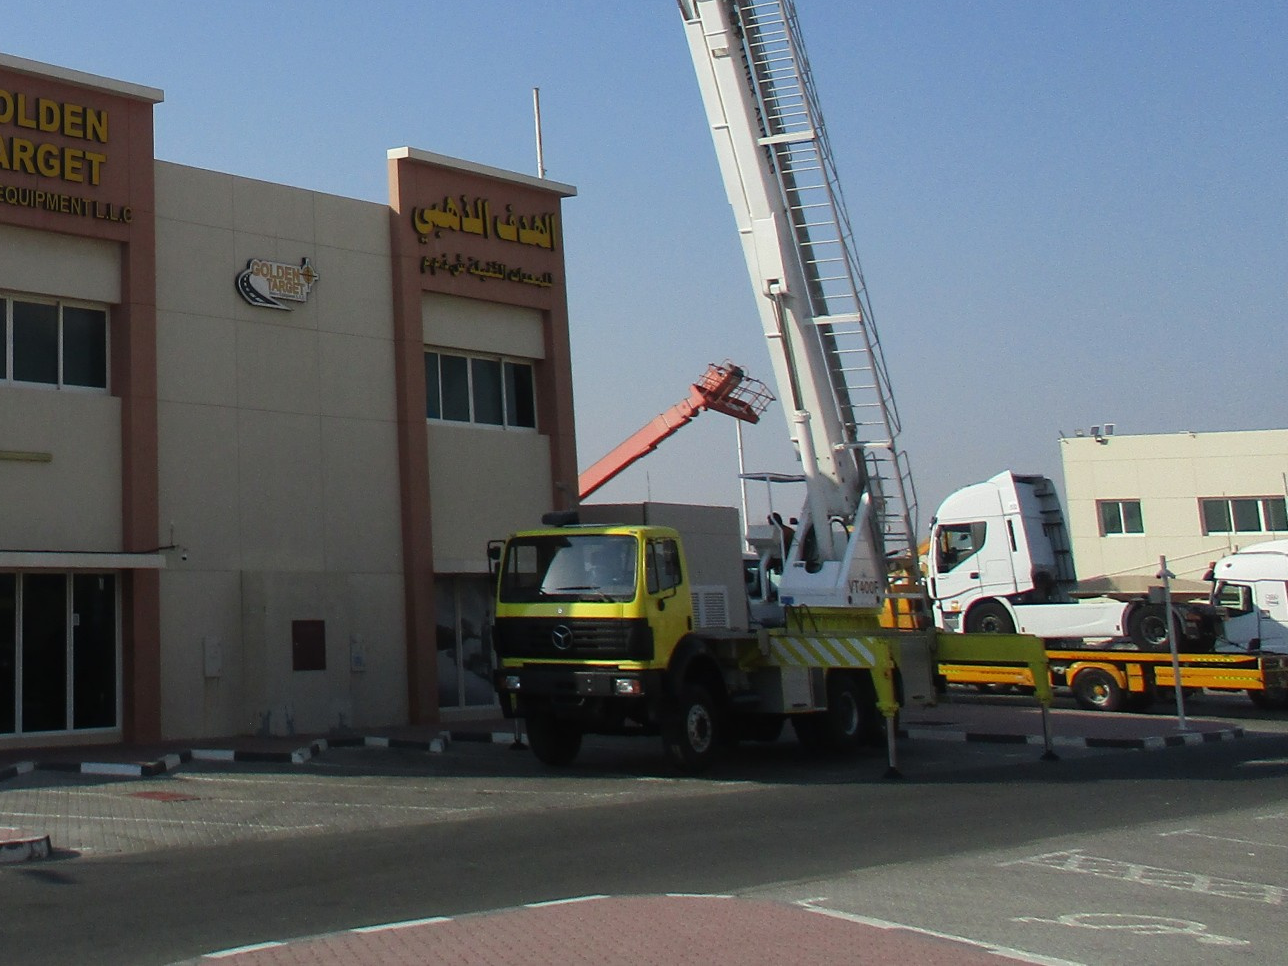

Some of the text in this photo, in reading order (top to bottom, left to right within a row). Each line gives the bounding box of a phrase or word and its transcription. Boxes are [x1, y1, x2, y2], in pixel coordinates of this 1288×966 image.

[414, 194, 557, 251] الهدف الذهبي
[252, 261, 301, 282] GOLDEN
[267, 278, 307, 295] TARGET
